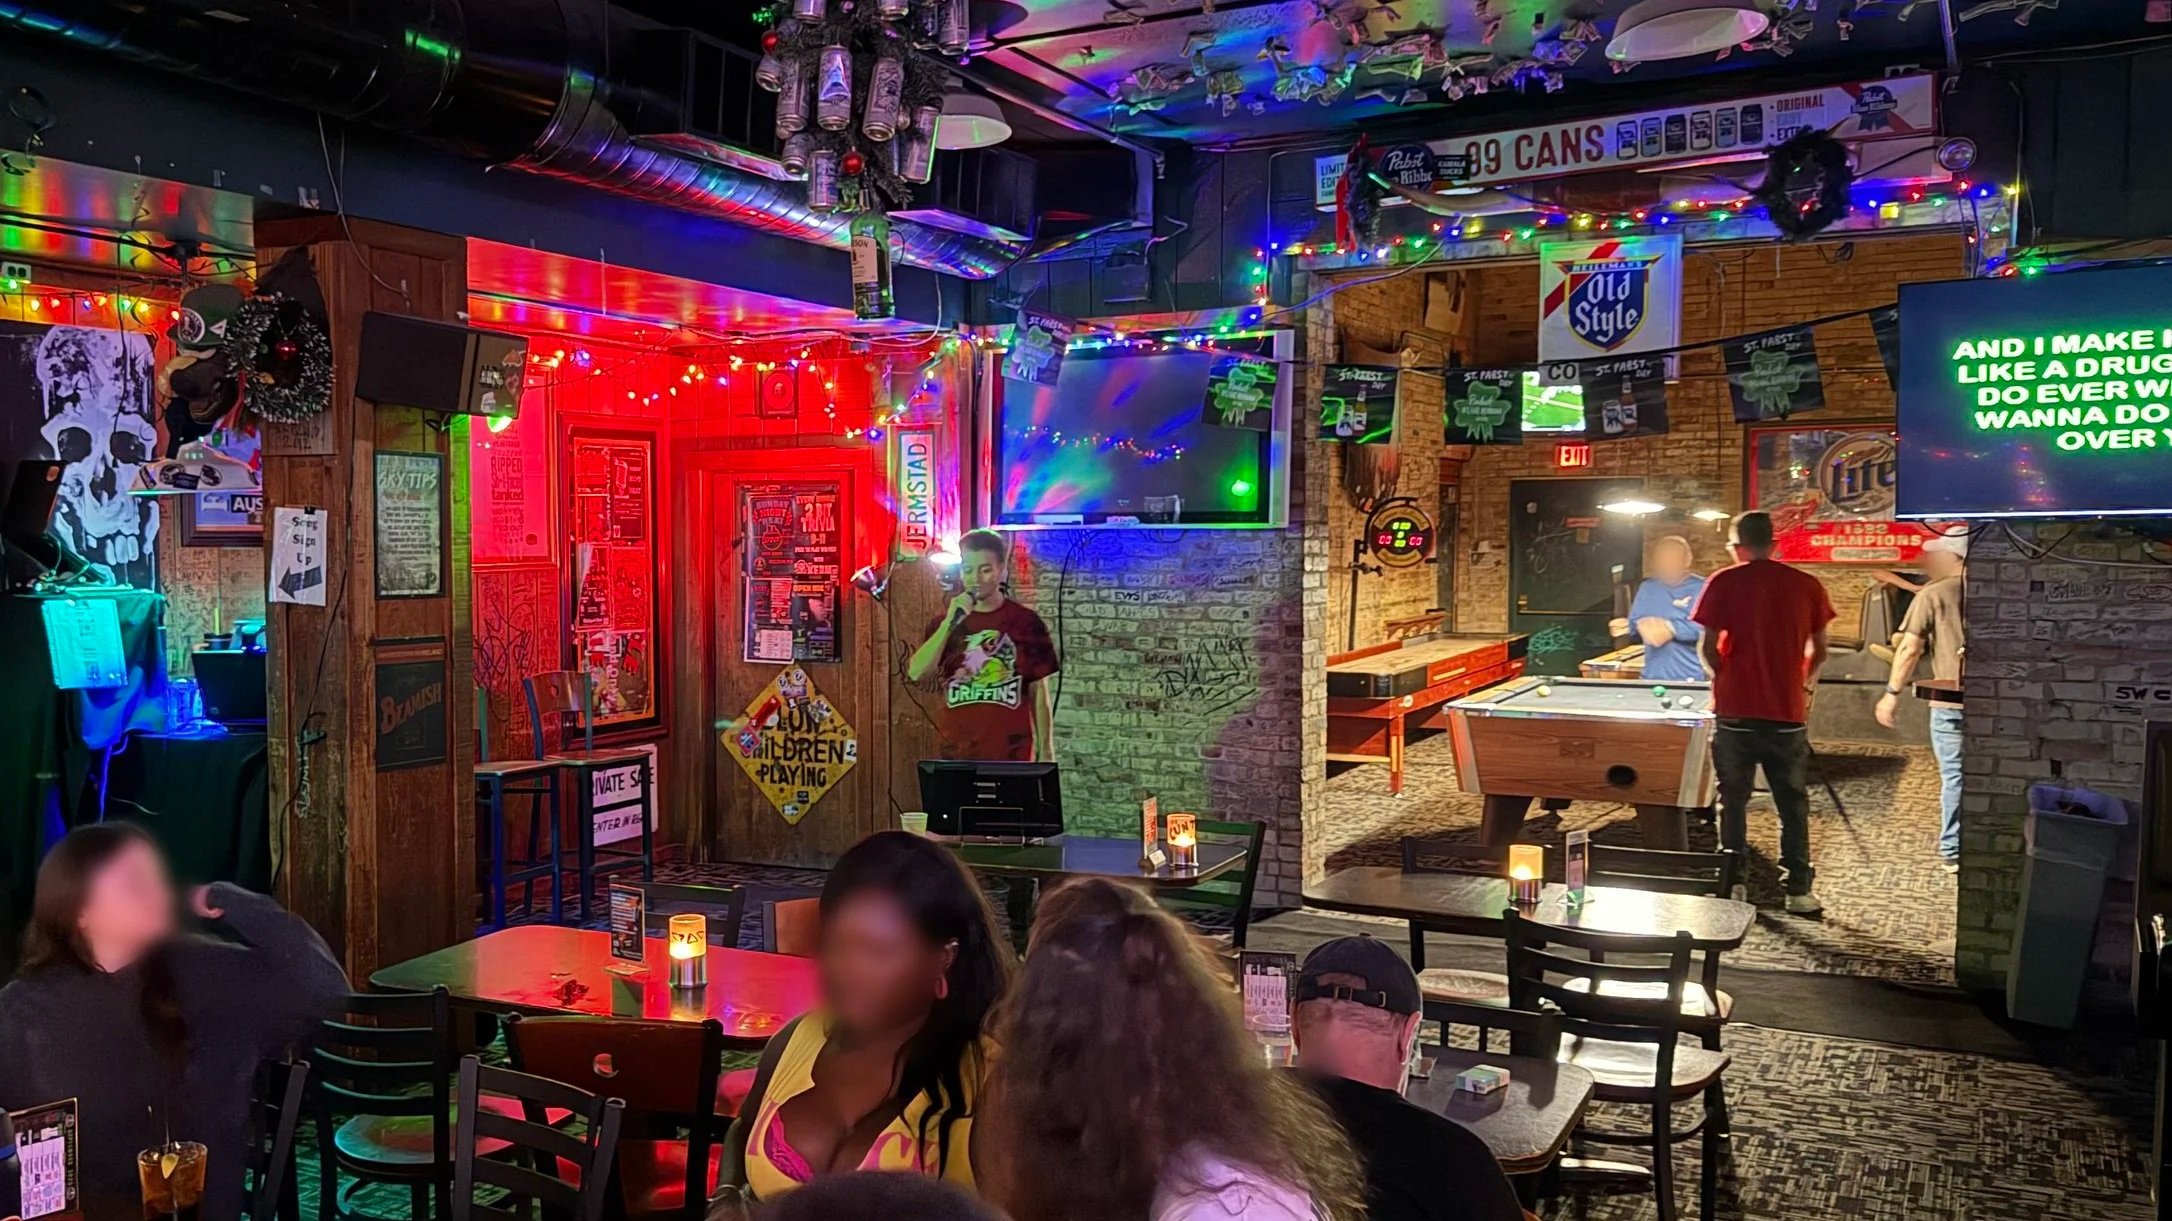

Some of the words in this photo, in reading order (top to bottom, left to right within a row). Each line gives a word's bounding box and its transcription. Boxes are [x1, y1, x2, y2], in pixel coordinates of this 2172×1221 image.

[1777, 94, 1824, 112] ORIGINAL
[1515, 125, 1604, 170] CANS
[1321, 161, 1344, 177] LIMIT
[1388, 150, 1425, 172] Pabst
[1438, 159, 1466, 168] KAMALA
[1439, 167, 1464, 176] SUCKS
[1587, 271, 1631, 304] Old
[1575, 302, 1638, 343] Style
[1761, 333, 1794, 349] PABST
[1953, 338, 2025, 360] AND
[2034, 337, 2044, 356] I
[2052, 330, 2155, 354] MAKE
[1480, 370, 1508, 380] PABST
[1613, 360, 1646, 372] PABST
[1958, 361, 2036, 383] LIKE
[2042, 360, 2068, 379] A
[2075, 354, 2172, 377] DRUG
[1977, 385, 2029, 406] DO
[2037, 381, 2128, 403] EVER
[2134, 378, 2172, 399] W
[1974, 406, 2108, 429] WANNA
[2115, 403, 2170, 424] DO
[2056, 428, 2156, 451] OVER
[491, 456, 523, 473] RIPPED
[1560, 445, 1589, 467] EXIT
[408, 472, 437, 489] TIPS
[233, 497, 263, 511] AUS
[492, 489, 524, 501] tanked
[907, 443, 927, 549] JERMSTAD
[801, 516, 835, 532] TRIVIA
[292, 534, 316, 548] Sign
[1811, 535, 1922, 546] CHAMPIONS
[948, 681, 1017, 705] GRIFFINS
[380, 682, 441, 735] BEAMISH
[760, 763, 826, 788] PLAYING
[1169, 820, 1195, 841] CUNT
